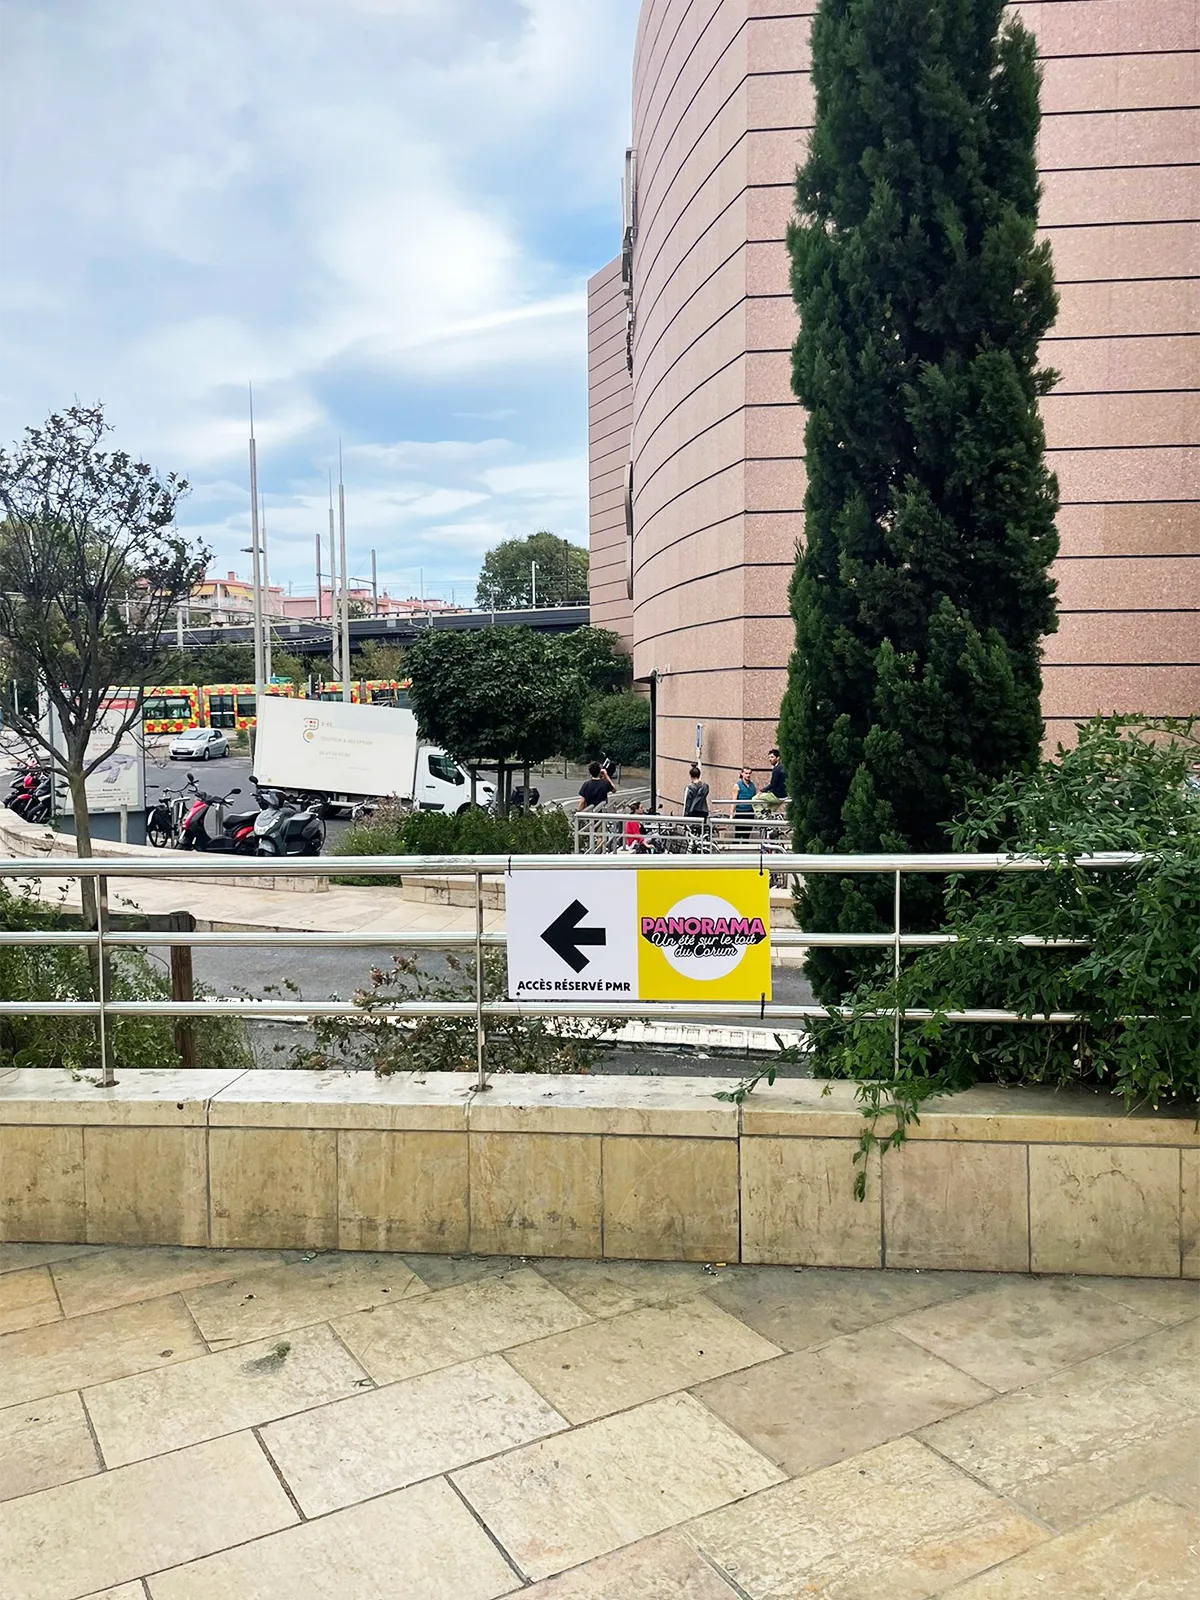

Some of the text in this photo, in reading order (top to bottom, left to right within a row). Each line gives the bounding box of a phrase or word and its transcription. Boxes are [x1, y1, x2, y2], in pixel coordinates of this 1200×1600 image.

[641, 917, 766, 936] PANORAMA
[652, 933, 757, 946] Un été sur le toit
[674, 944, 738, 958] du Corum
[517, 978, 631, 992] ACCÈS RÉSERVÉ PMR
